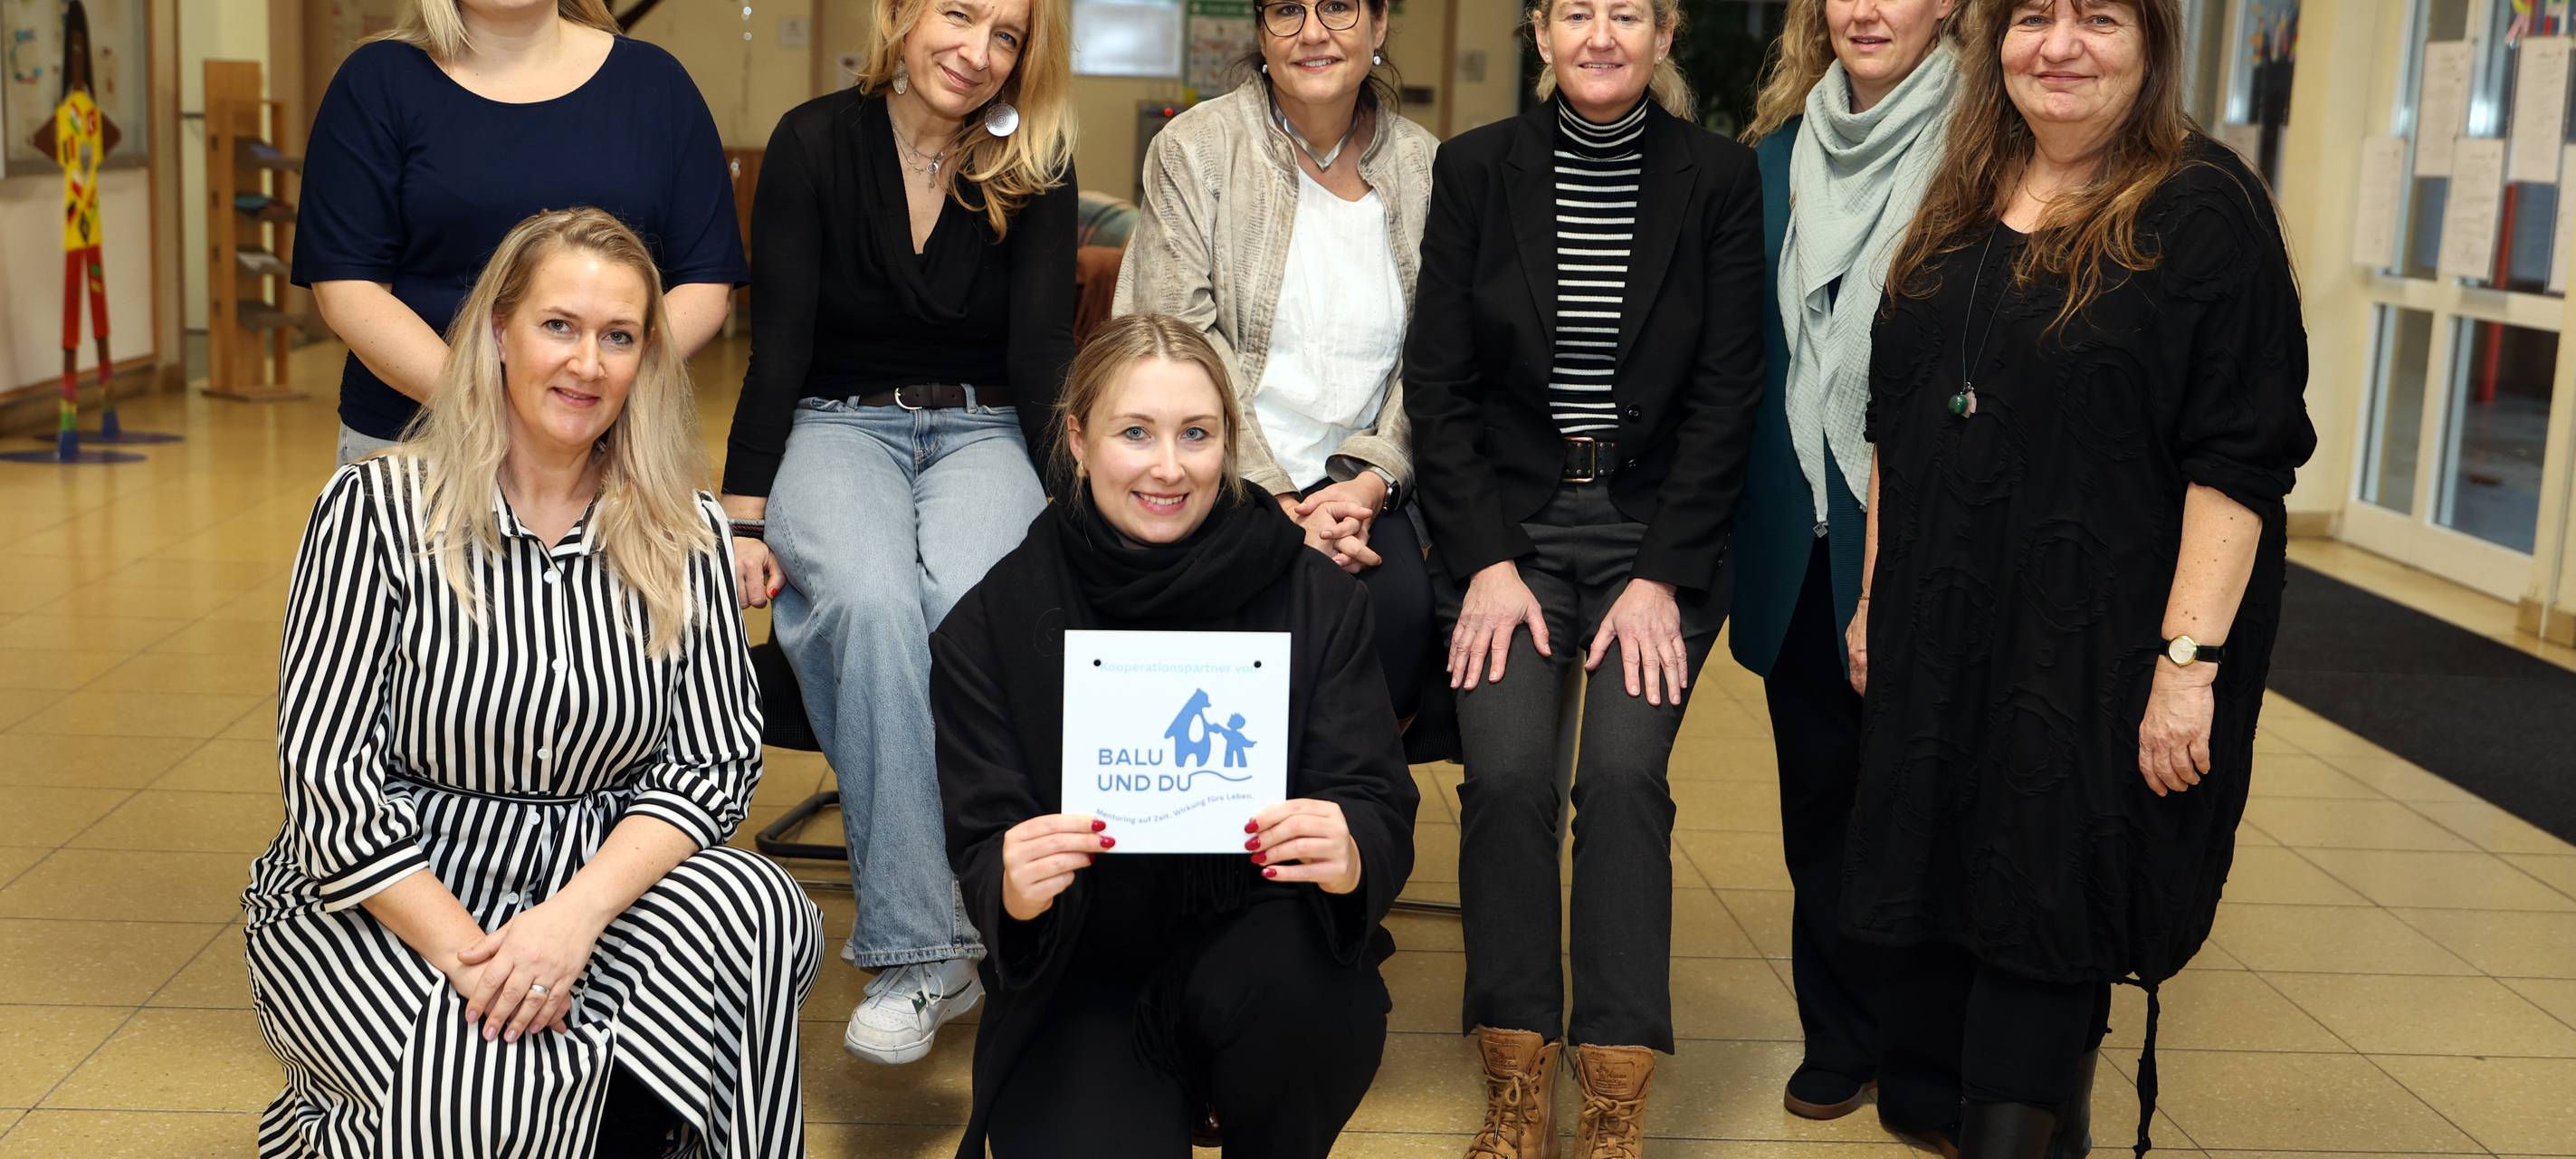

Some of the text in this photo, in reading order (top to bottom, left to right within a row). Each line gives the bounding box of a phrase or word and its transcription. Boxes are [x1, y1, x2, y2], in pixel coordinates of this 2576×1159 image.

[1100, 662, 1230, 674] Kooperationspartner
[1098, 749, 1163, 765] BALU
[1097, 774, 1191, 791] UND DU
[1095, 808, 1136, 825] Mentoring
[1138, 815, 1152, 823] auf
[1172, 800, 1207, 817] Wirkung
